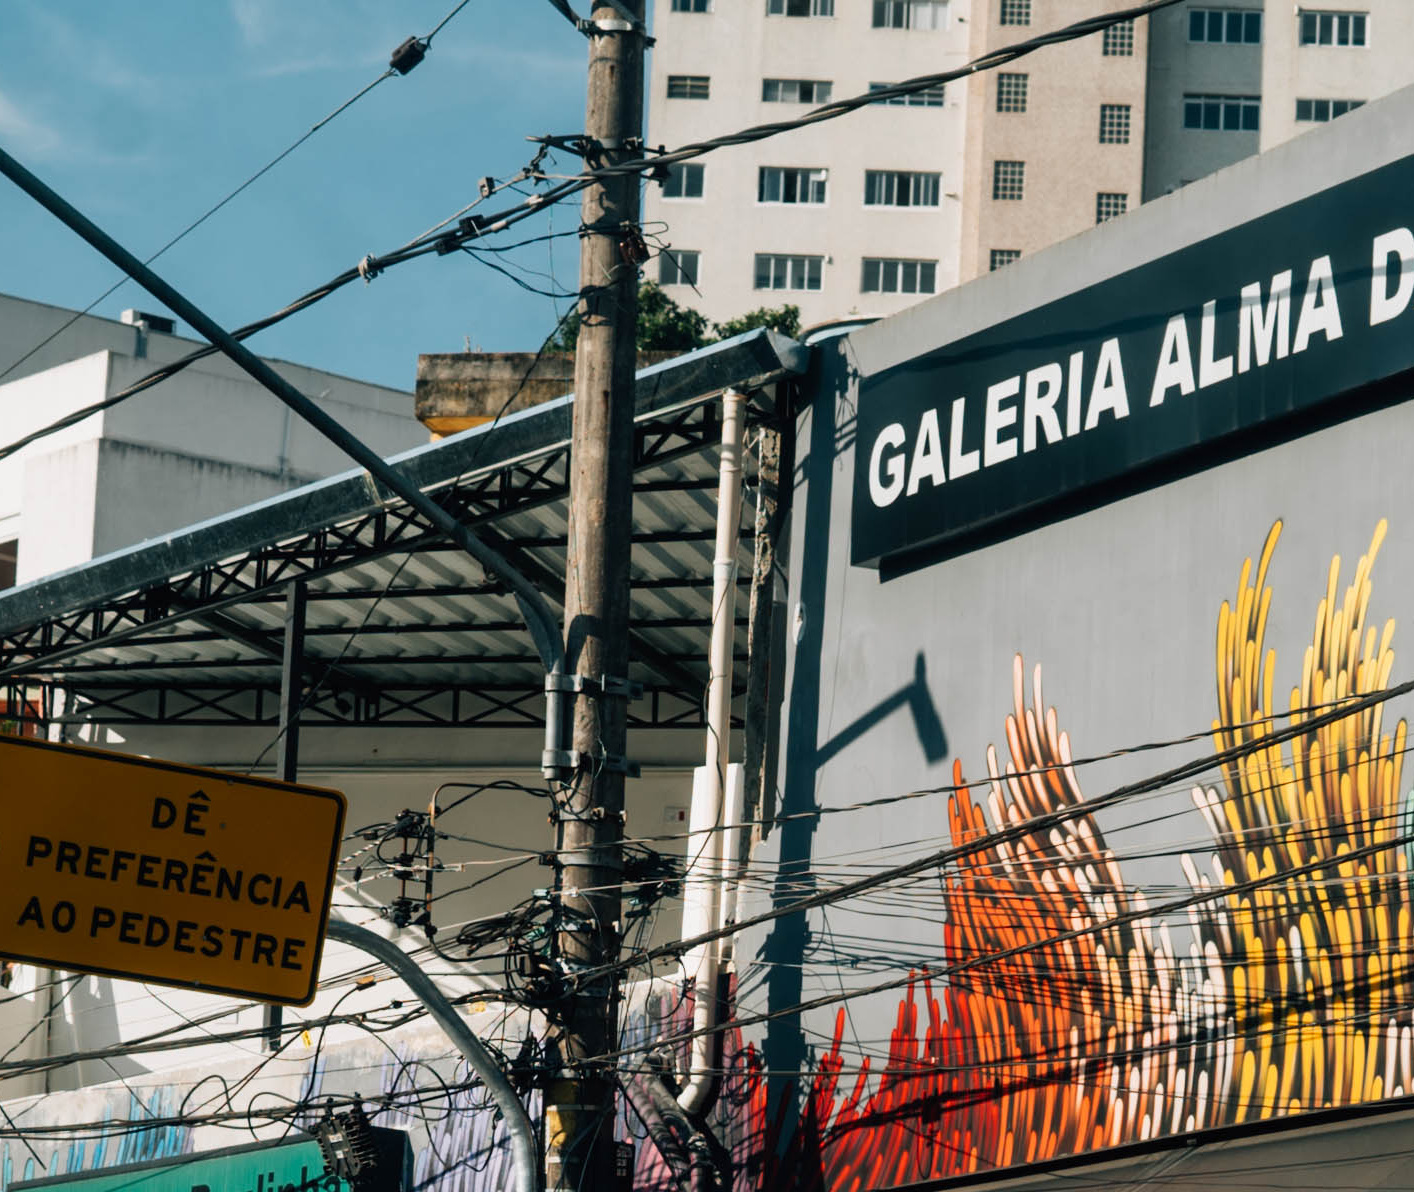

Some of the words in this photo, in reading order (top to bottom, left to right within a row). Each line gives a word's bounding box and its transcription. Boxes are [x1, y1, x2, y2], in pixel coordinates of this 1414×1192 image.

[867, 337, 1130, 508] GALERIA
[1148, 253, 1344, 408] ALMA
[151, 791, 211, 837] DÊ
[25, 834, 312, 914] PREFERÊNCIA
[17, 896, 78, 933] AO
[88, 910, 308, 972] PEDESTRE
